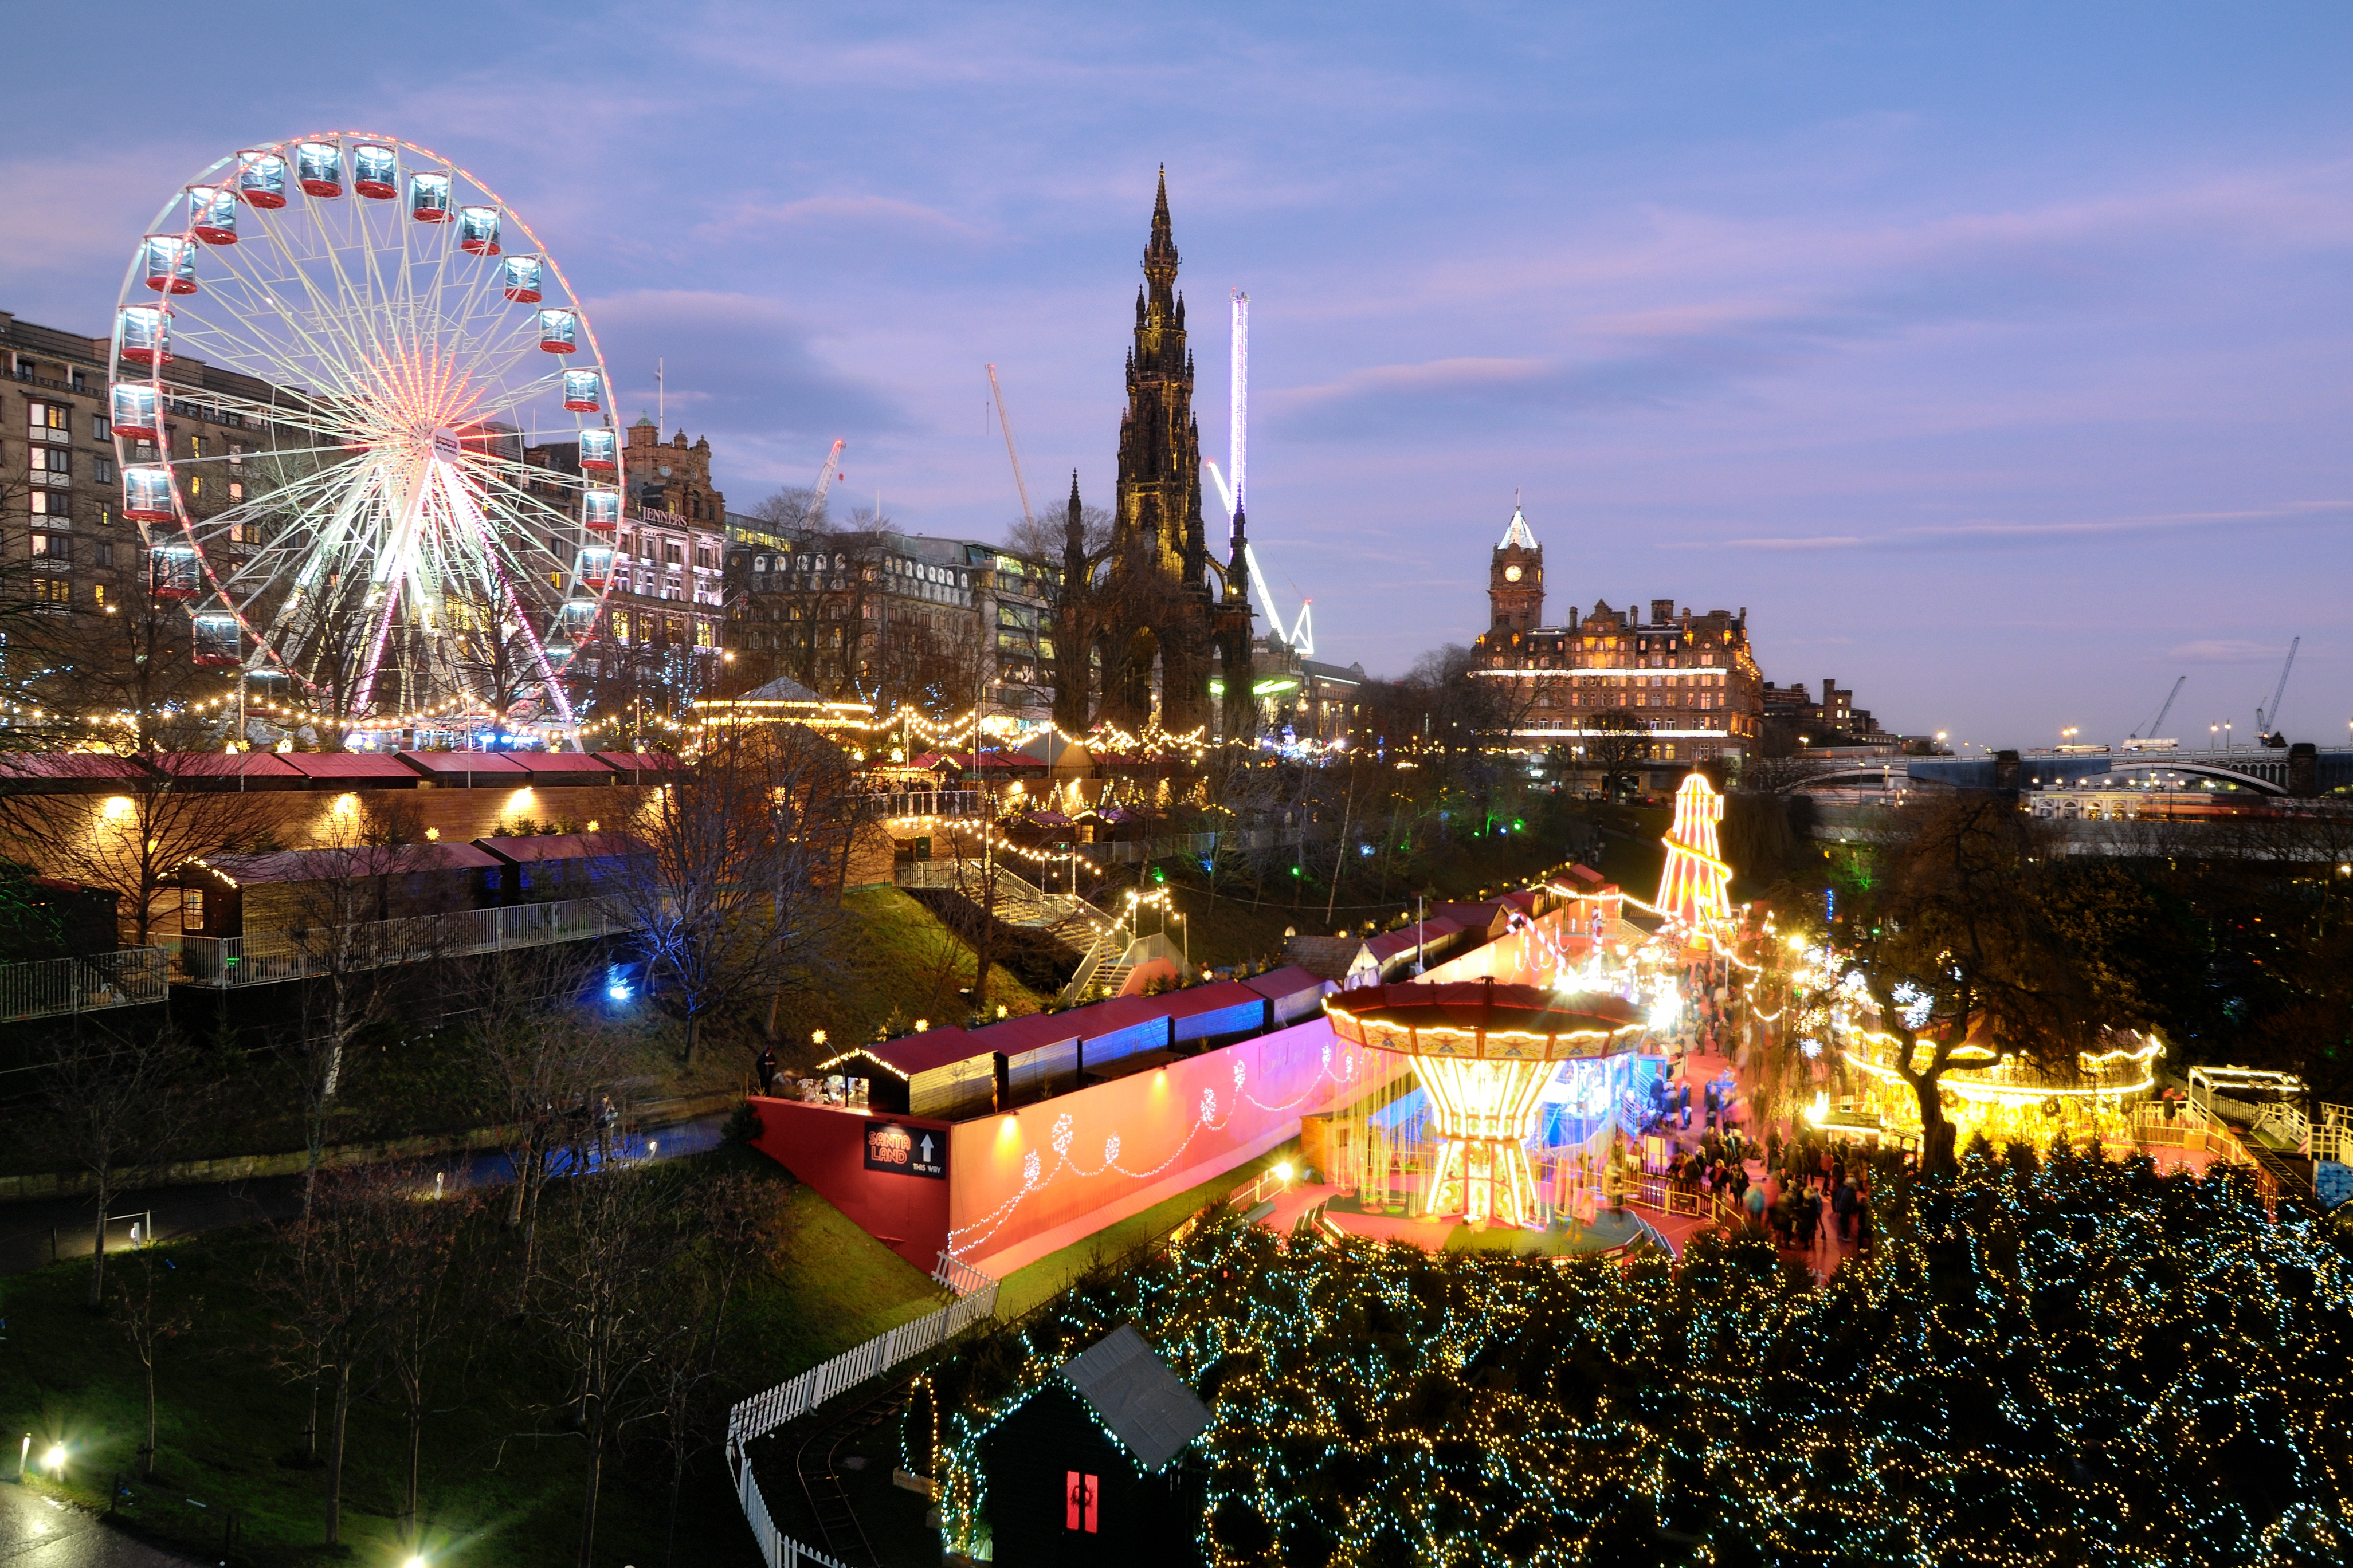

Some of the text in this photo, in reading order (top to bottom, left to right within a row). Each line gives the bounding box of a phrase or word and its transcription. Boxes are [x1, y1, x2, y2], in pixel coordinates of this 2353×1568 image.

[639, 506, 687, 527] JENNERS
[868, 1131, 911, 1150] SANTA
[871, 1146, 907, 1164] LAND
[912, 1162, 942, 1173] THIS WAY
